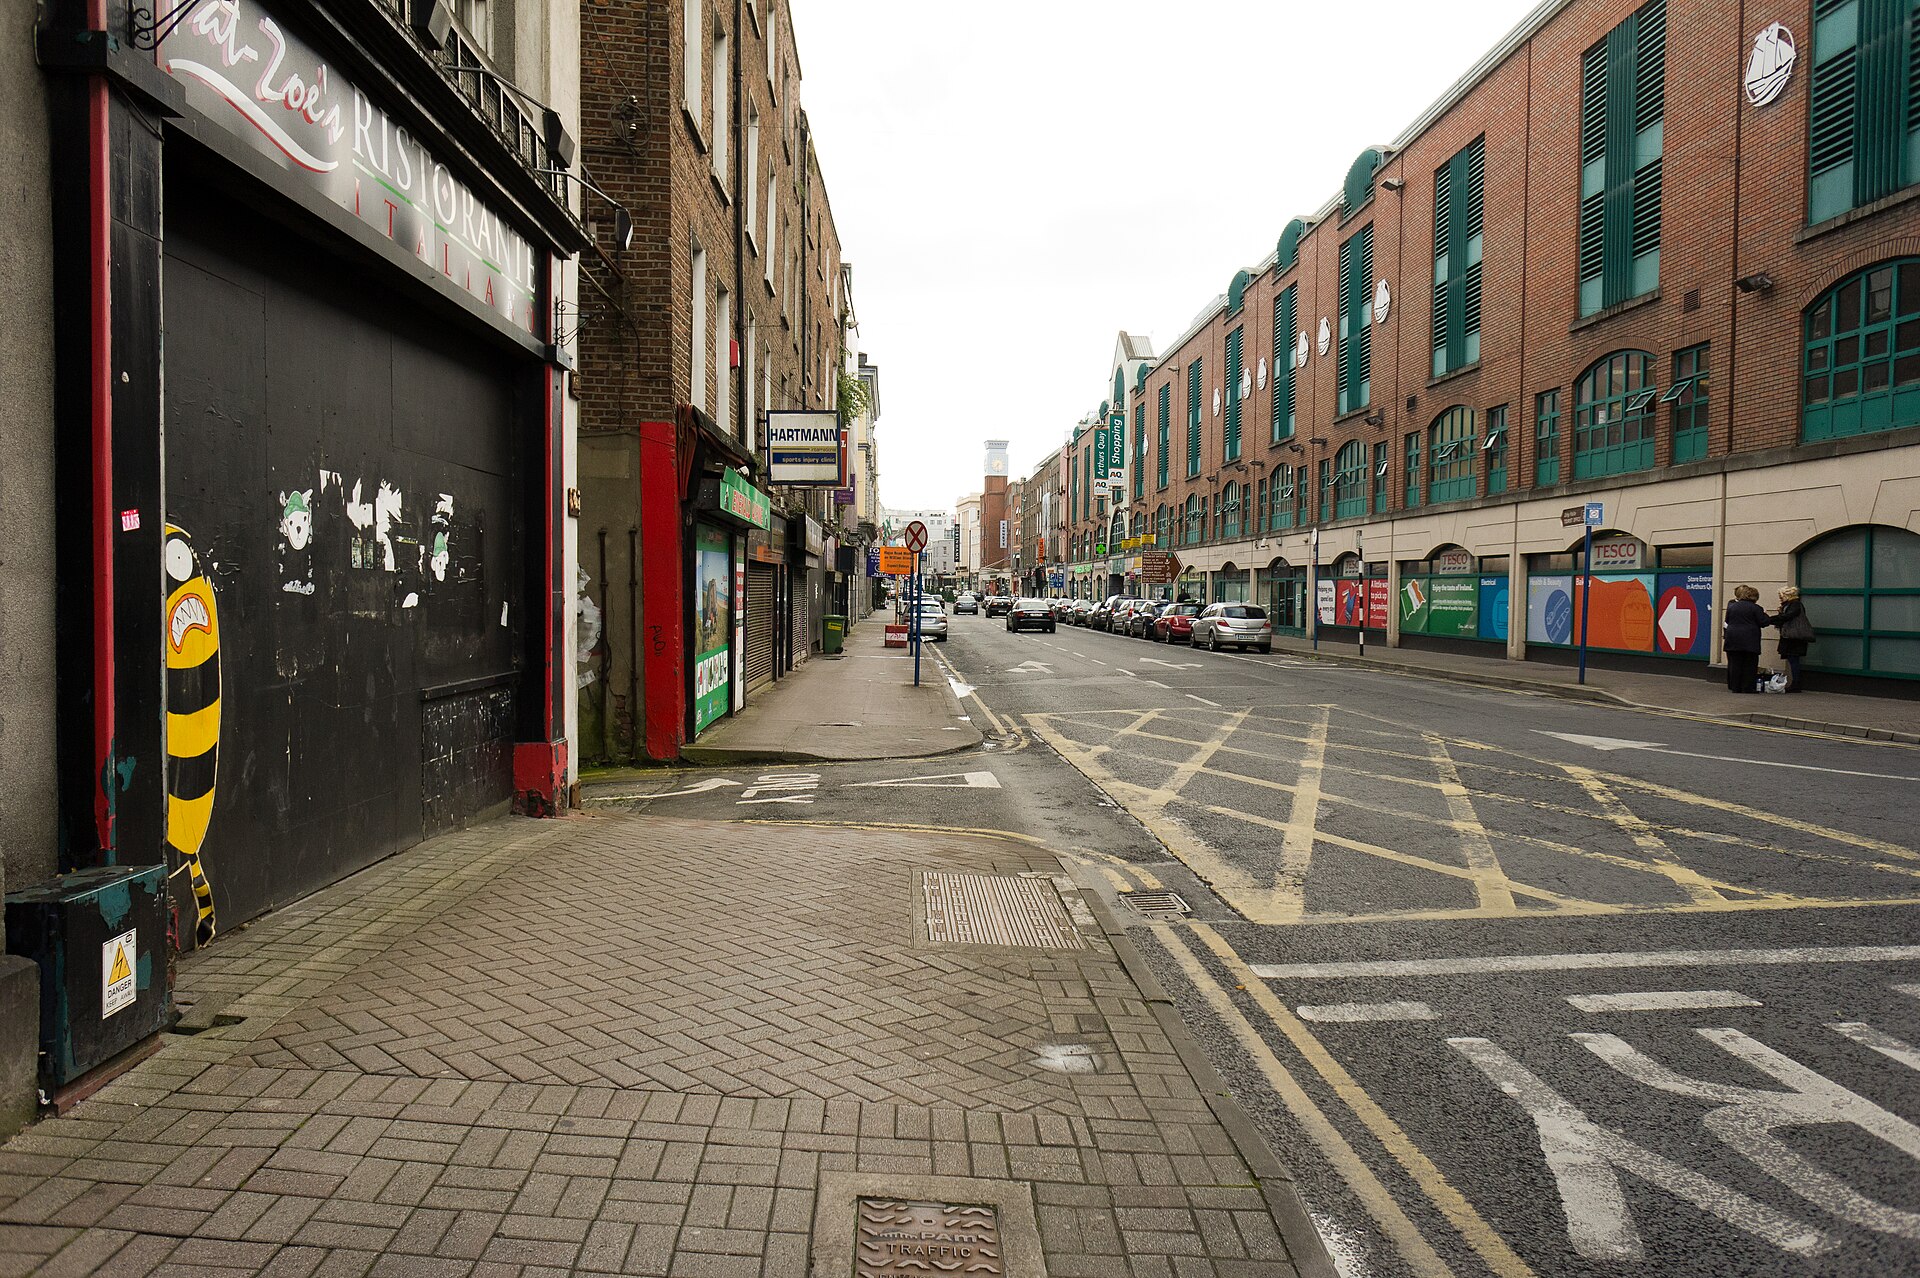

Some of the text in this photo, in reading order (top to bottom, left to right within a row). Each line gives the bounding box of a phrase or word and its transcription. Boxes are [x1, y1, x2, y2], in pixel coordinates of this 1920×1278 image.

[351, 82, 537, 294] RISTORANTE
[354, 176, 536, 334] ITALIANO
[770, 428, 838, 442] HARTMANN
[1111, 419, 1123, 465] Shopping
[1097, 431, 1107, 476] Arthurs Quay
[1442, 553, 1468, 565] TESCO
[1594, 543, 1637, 559] TESCO
[1346, 560, 1359, 569] TESC
[1575, 577, 1592, 587] Baky
[107, 979, 132, 999] DANGER
[105, 989, 133, 1009] KEEP AWAY
[886, 1243, 972, 1258] TRAFFIC
